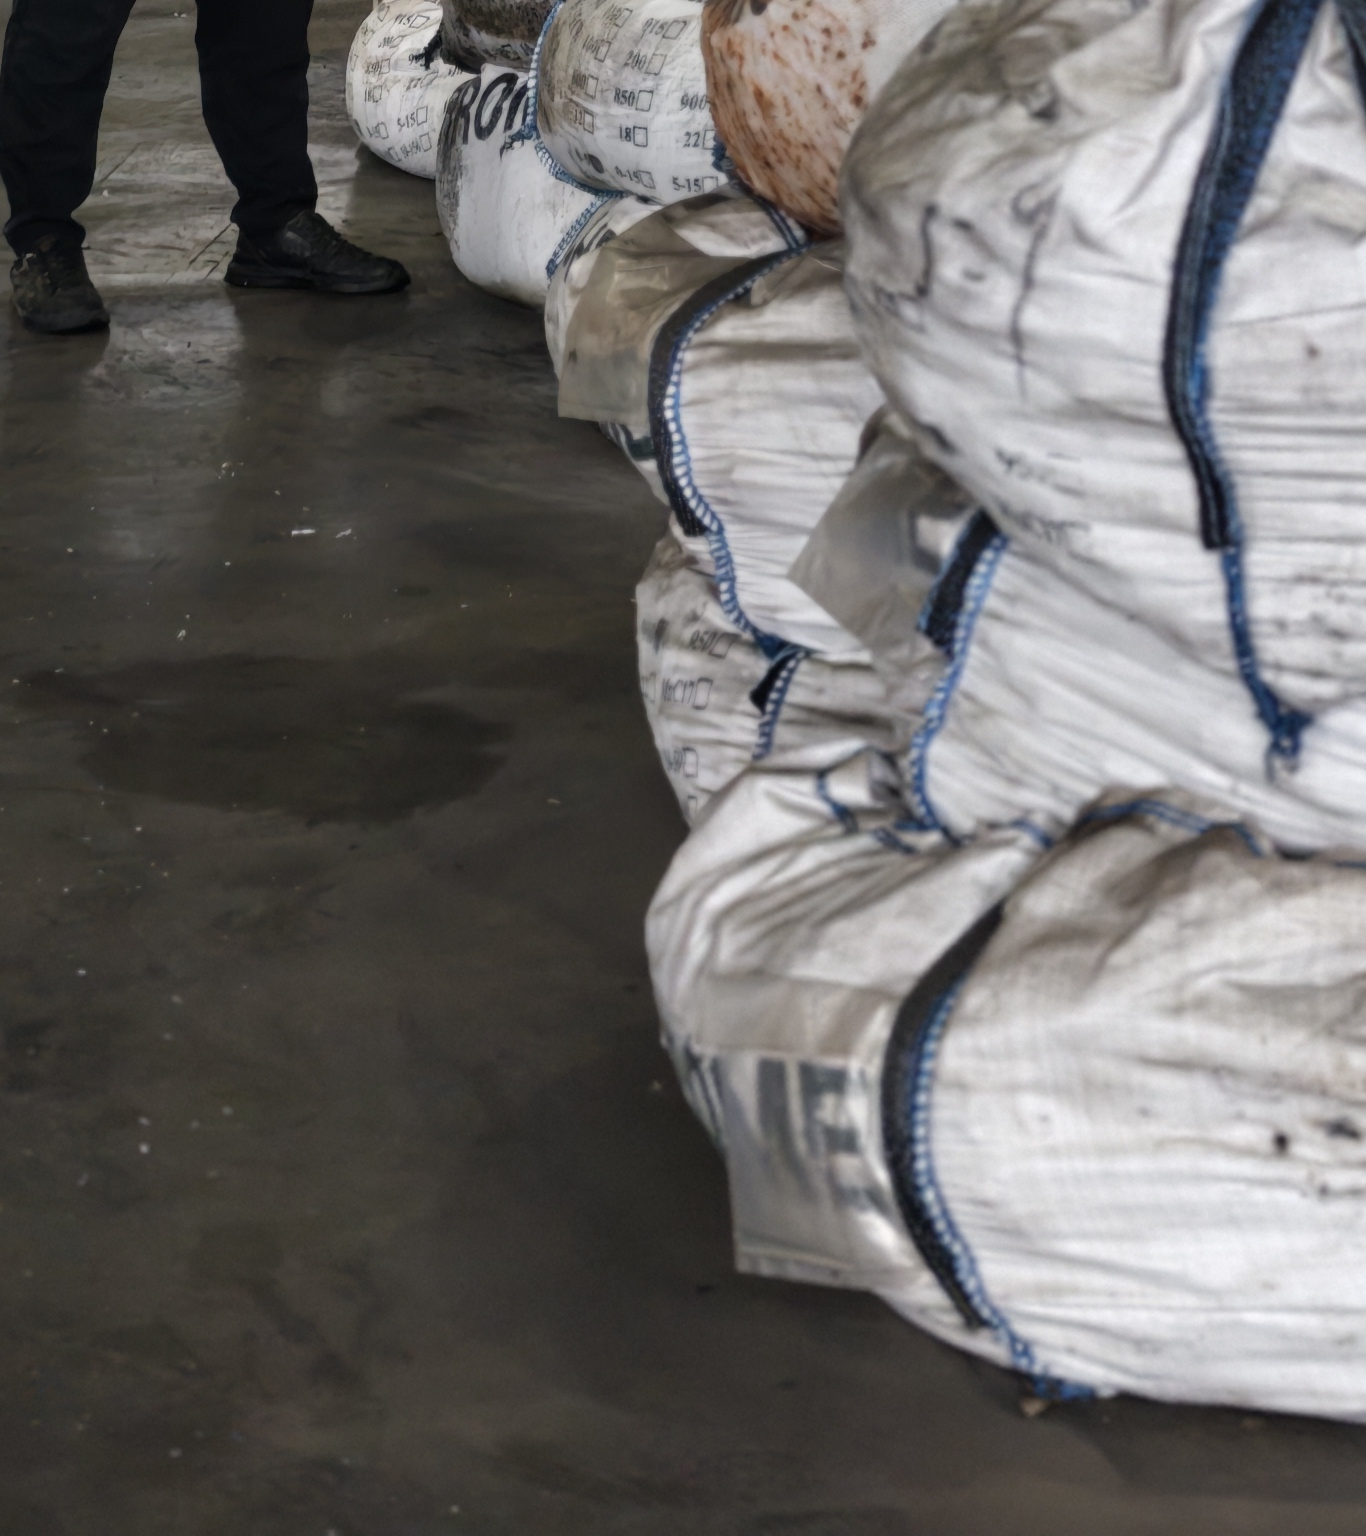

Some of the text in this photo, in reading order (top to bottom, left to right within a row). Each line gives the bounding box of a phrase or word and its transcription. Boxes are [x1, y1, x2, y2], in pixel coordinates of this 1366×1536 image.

[613, 88, 635, 107] 850
[680, 94, 709, 112] 900
[619, 125, 632, 142] 18
[683, 130, 701, 148] 22
[672, 176, 702, 193] 5-15
